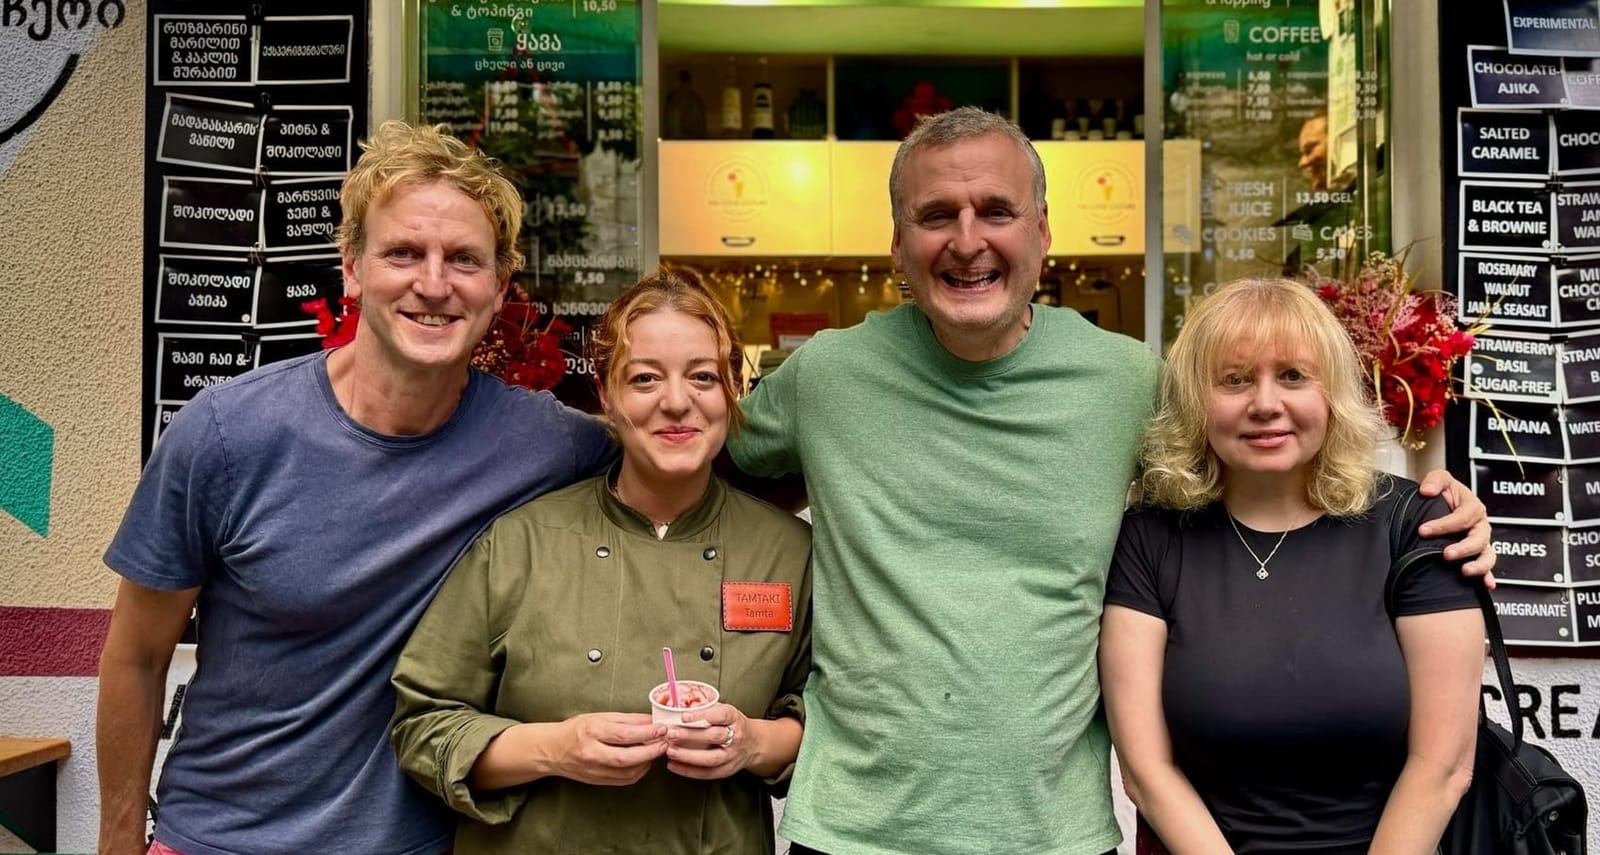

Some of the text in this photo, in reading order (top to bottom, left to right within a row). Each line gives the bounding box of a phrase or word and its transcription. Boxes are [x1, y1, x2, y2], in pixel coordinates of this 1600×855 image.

[451, 5, 462, 16] &
[163, 22, 247, 35] როზმარინი
[1513, 17, 1596, 29] EXPERIMENTAL
[516, 33, 562, 51] ყავა
[1250, 27, 1320, 43] COFFEE
[170, 37, 240, 50] მარილით
[172, 52, 238, 64] & კაკლის
[173, 66, 237, 79] მურაბით
[1498, 83, 1540, 94] AJIKA
[280, 123, 330, 136] პიტნა &
[1480, 127, 1530, 140] SALTED
[189, 134, 236, 150] ვანილი
[1560, 132, 1600, 147] CHOC
[266, 145, 342, 158] შოკოლადი
[1471, 146, 1540, 160] CARAMEL
[1227, 182, 1274, 196] FRESH
[1296, 192, 1352, 204] 13,50 GEL
[173, 205, 254, 222] შოკოლადი
[287, 206, 331, 220] ჯემი &
[1227, 202, 1273, 216] JUICE
[1472, 200, 1543, 214] BLACK TEA
[286, 223, 333, 237] ვაფლი
[1468, 219, 1547, 234] & BROWNIE
[1203, 227, 1276, 242] COOKIES
[1478, 262, 1537, 277] ROSEMARY
[168, 273, 250, 288] შოკოლადი
[286, 284, 317, 298] ყავა
[1484, 282, 1531, 297] WALNUT
[1467, 301, 1548, 317] JAM & SEASALT
[1472, 338, 1555, 355] STRAWBERRY
[172, 352, 204, 365] შავი
[209, 353, 232, 366] ჩაი
[1496, 360, 1531, 373] BASIL
[1475, 377, 1552, 394] SUGAR-FREE
[1488, 417, 1551, 435] BANANA
[1493, 481, 1545, 496] LEMON
[1569, 532, 1600, 546] CHO
[1492, 541, 1547, 557] GRAPES
[736, 593, 780, 604] TAMTAKI
[746, 608, 774, 618] Tamta
[1494, 602, 1567, 617] OMEGRANATE
